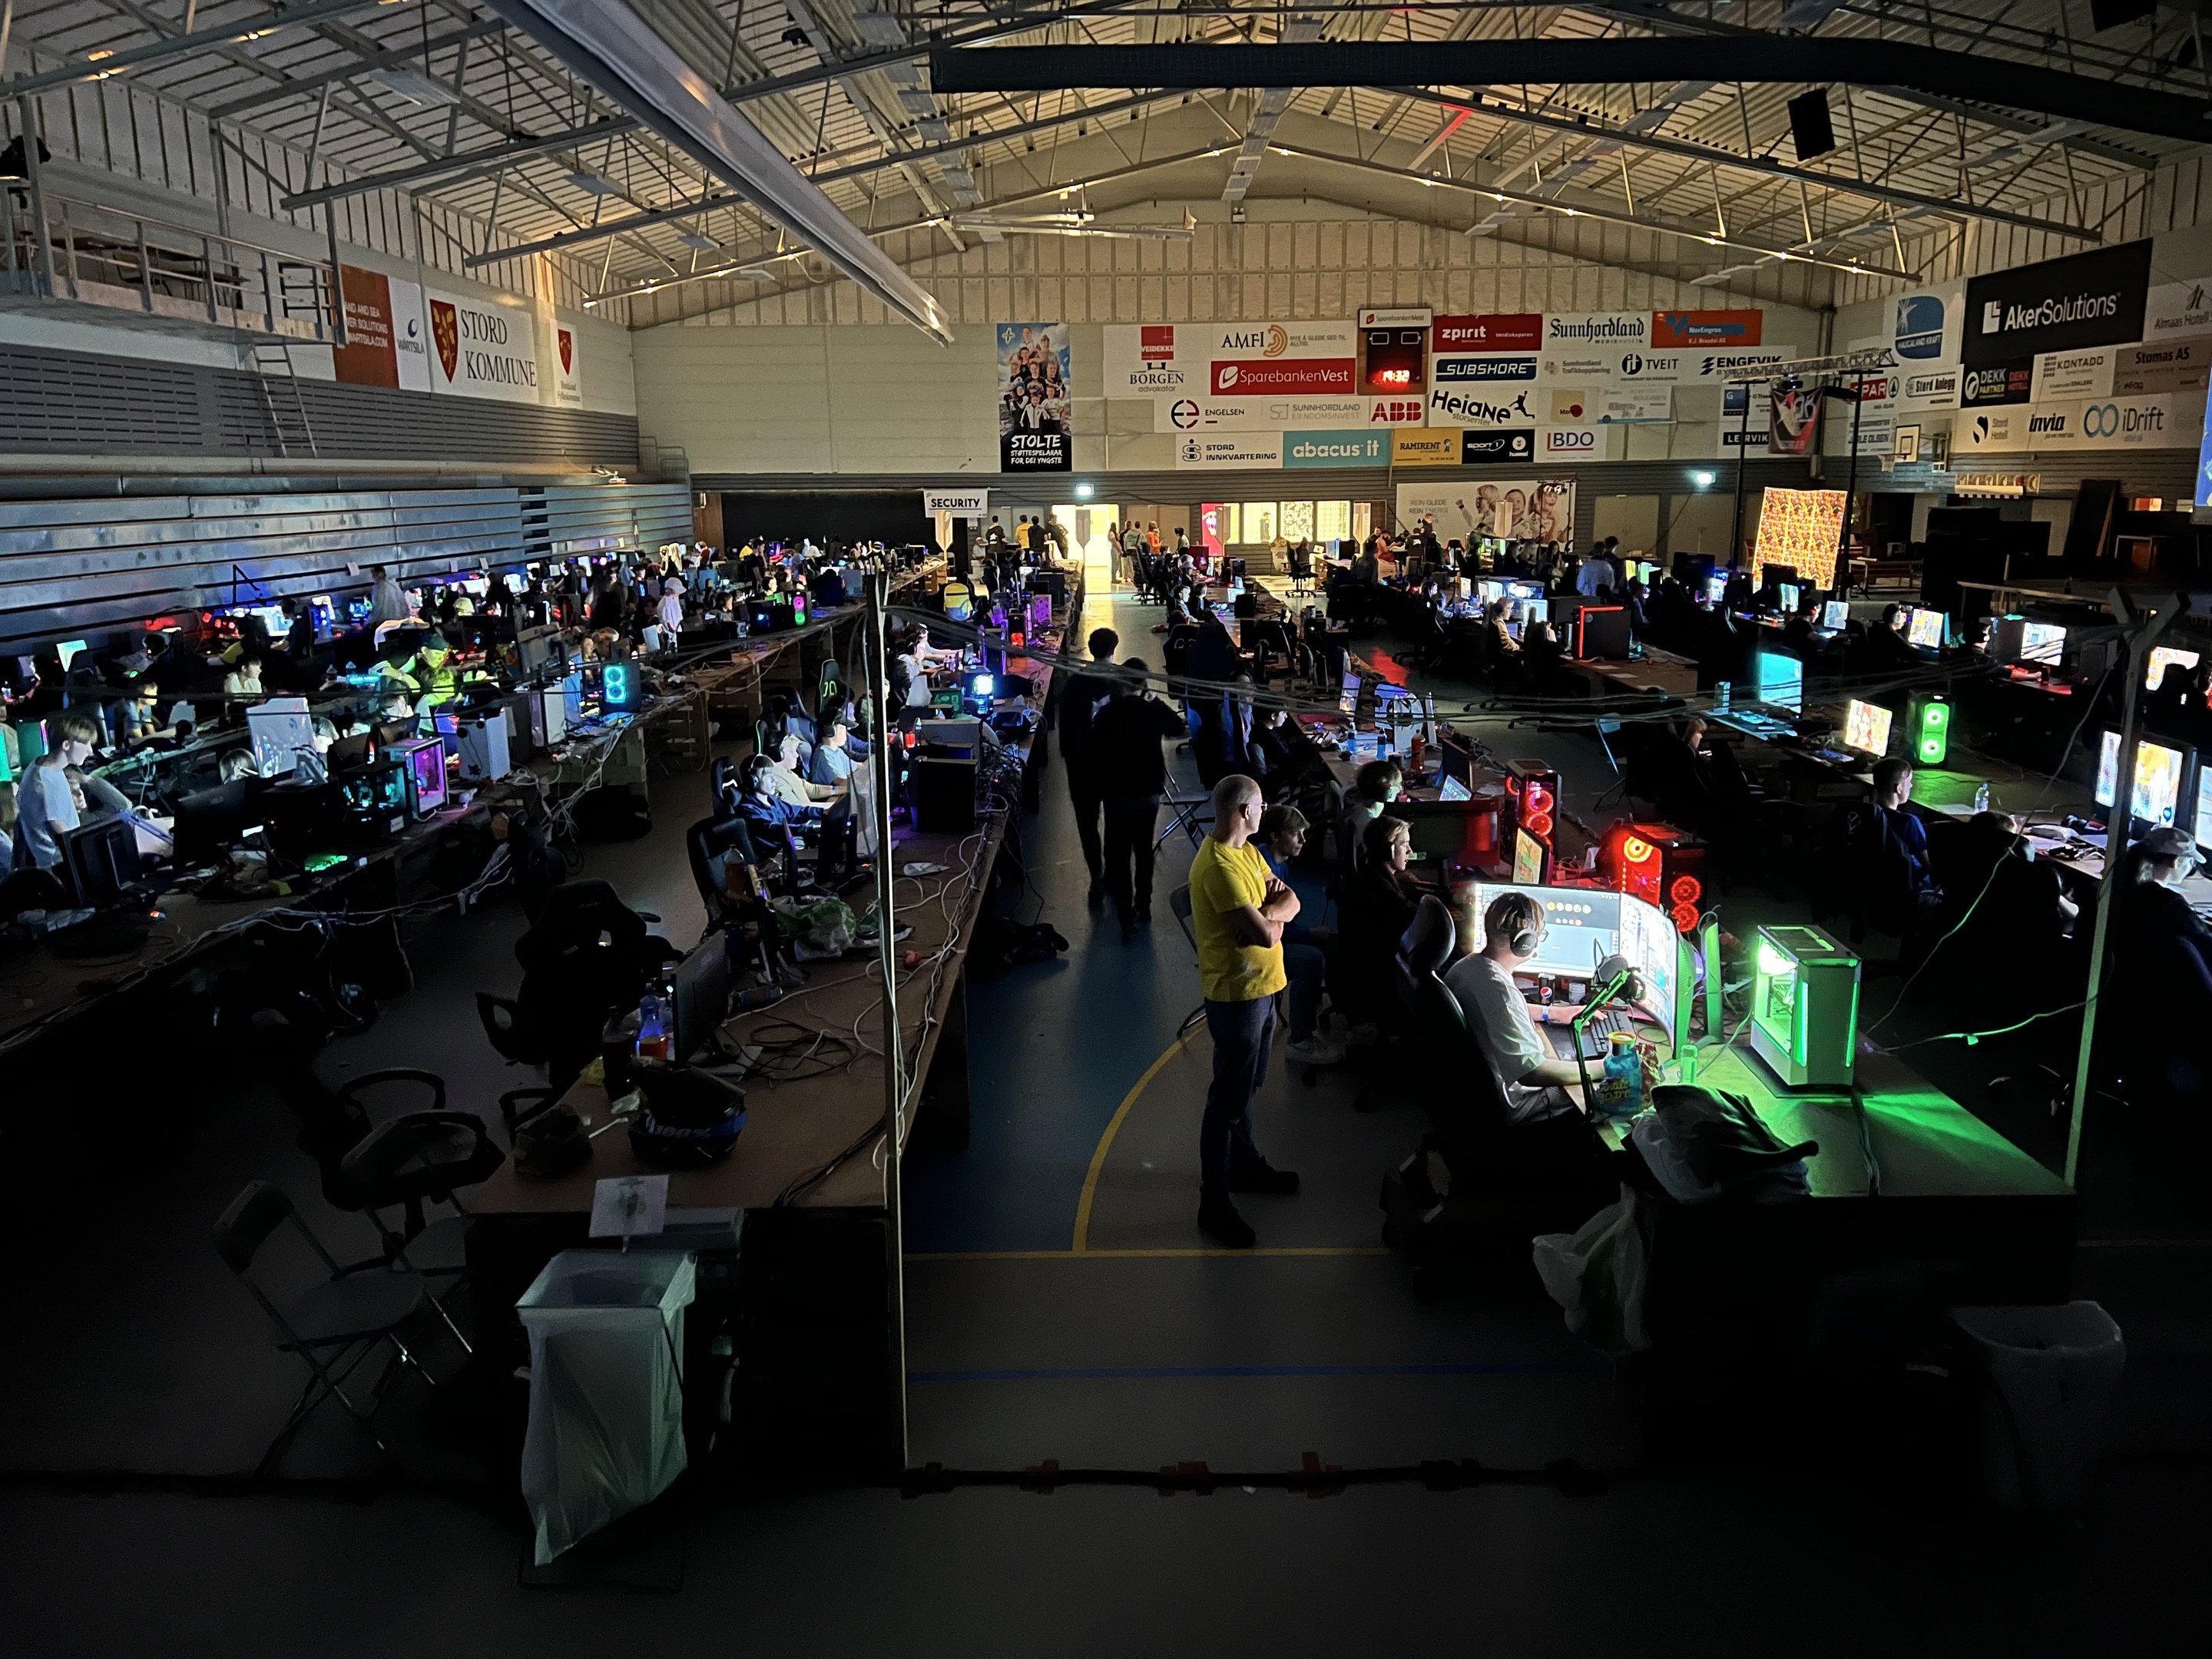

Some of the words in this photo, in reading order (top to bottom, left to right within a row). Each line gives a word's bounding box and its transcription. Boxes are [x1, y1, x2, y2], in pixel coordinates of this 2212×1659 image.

[357, 303, 369, 315] AND
[369, 306, 381, 318] SEA
[2005, 293, 2117, 331] AkerSolutions
[1376, 314, 1425, 323] SparebankenVest
[2184, 311, 2210, 326] Hotell
[357, 319, 389, 334] SOLUTIONS
[461, 309, 508, 345] STORD
[1442, 326, 1487, 340] zpirit
[1550, 317, 1644, 343] Sunnhordland
[1221, 332, 1265, 349] AMFI
[1926, 335, 1942, 344] KRAFT
[2057, 355, 2104, 369] KONTADO
[2135, 351, 2173, 364] Stomas
[2176, 346, 2190, 360] AS
[465, 350, 537, 387] KOMMUNE
[1446, 363, 1528, 375] SUBSHORE
[1646, 359, 1679, 369] TVEIT
[1130, 373, 1184, 385] BORGEN
[1240, 369, 1349, 384] SparebankenVest
[1980, 368, 2007, 384] DEKK
[2008, 369, 2029, 382] DEKK
[1853, 382, 1887, 399] PAR
[1916, 379, 1933, 392] Stord
[1979, 384, 2005, 394] PARTNER
[1292, 403, 1360, 412] SUNNHORDLAND
[1371, 402, 1422, 422] ABB
[1292, 412, 1359, 420] EIENDOMSINVEST
[1452, 412, 1492, 426] storsenter
[1992, 417, 2008, 428] Stord
[2029, 412, 2066, 432] invia
[2122, 406, 2164, 431] iDrift
[1011, 435, 1061, 449] STOLTE
[1553, 432, 1594, 446] BDO
[1727, 433, 1768, 443] LERVIK
[1991, 430, 2008, 440] Hotell
[1293, 442, 1360, 459] abacus
[1366, 440, 1379, 457] it
[1400, 442, 1441, 450] RAMIRENT
[1206, 452, 1277, 461] INNKVARTERING
[931, 498, 981, 508] SECURITY
